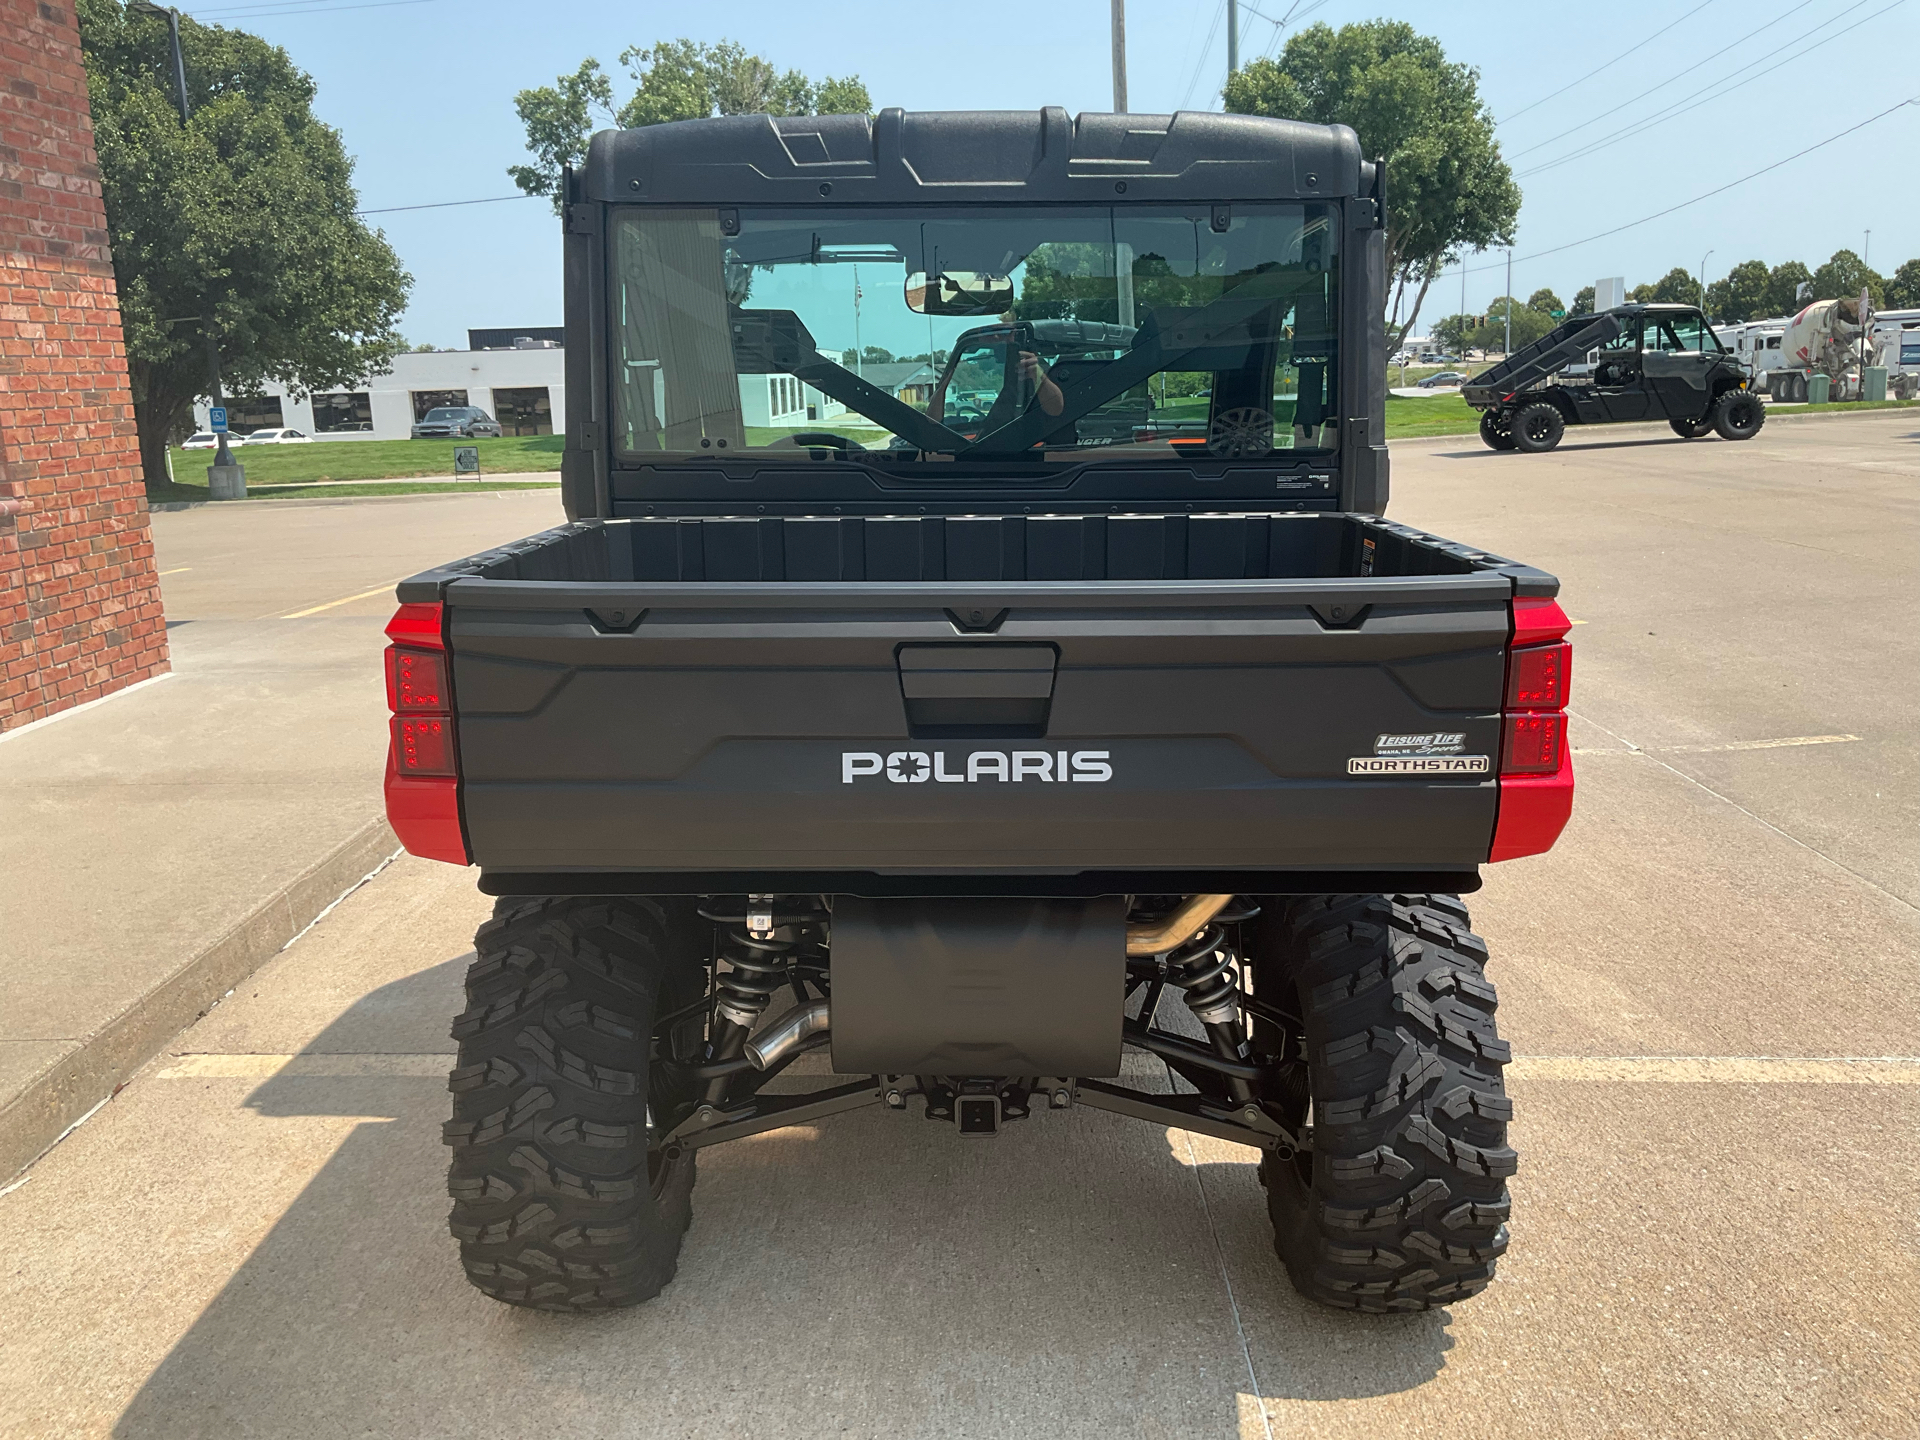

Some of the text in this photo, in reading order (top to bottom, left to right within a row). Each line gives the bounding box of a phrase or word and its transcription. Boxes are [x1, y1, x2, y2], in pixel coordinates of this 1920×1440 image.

[1076, 437, 1112, 446] NGER
[1377, 733, 1464, 747] LEISURE LIFE
[1415, 744, 1463, 755] Sports
[842, 750, 1113, 784] POLARIS
[1354, 759, 1483, 771] NORTHSTAR
